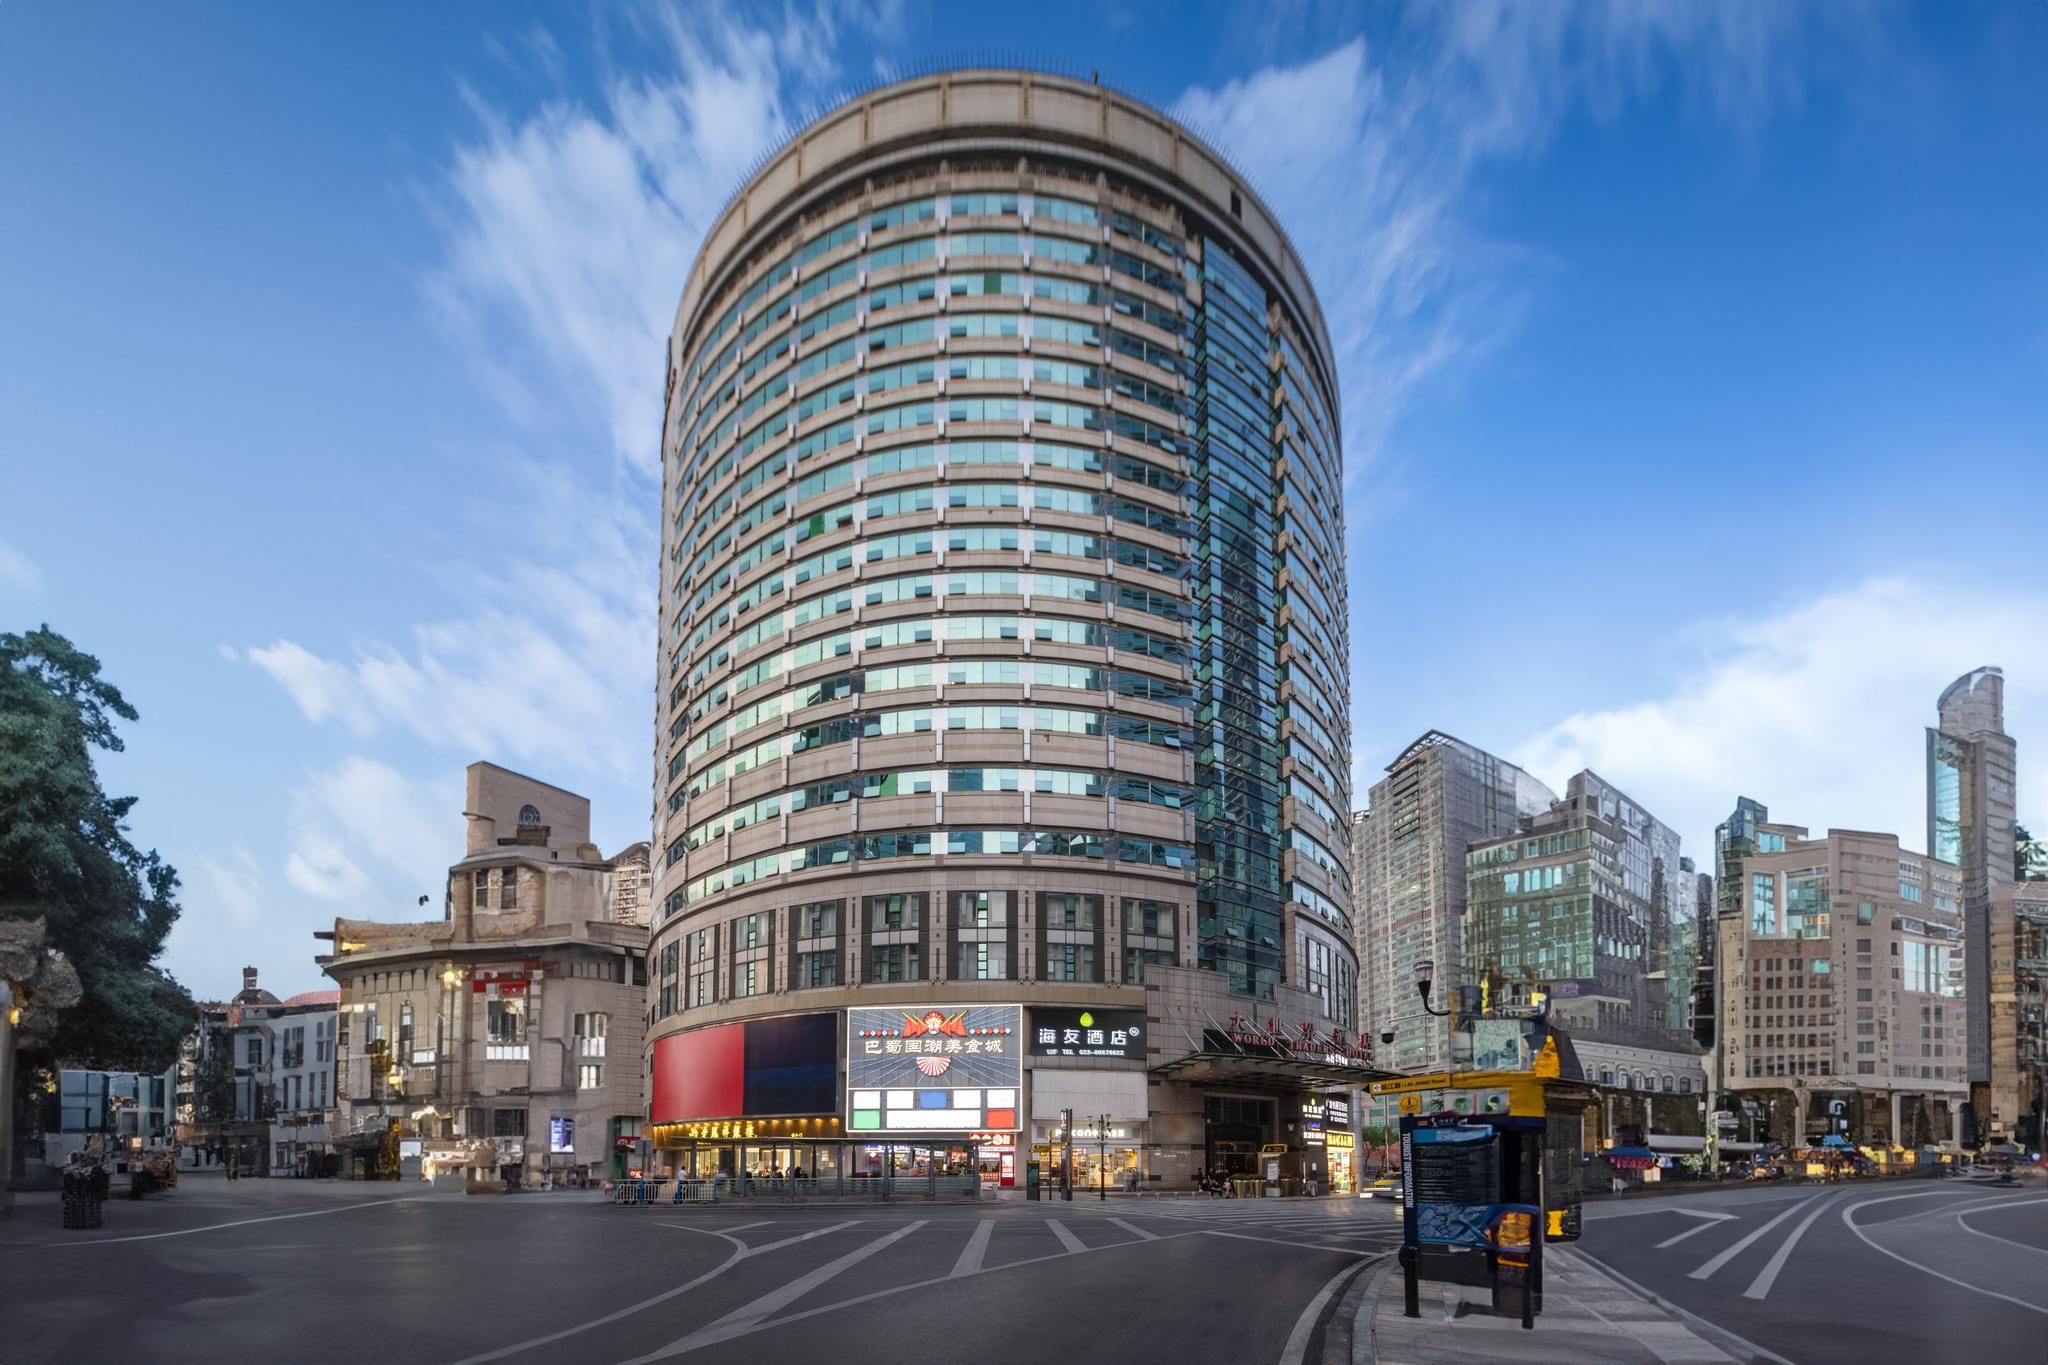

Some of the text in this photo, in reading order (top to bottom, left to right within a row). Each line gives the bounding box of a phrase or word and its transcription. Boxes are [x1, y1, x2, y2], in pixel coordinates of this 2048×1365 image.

[1039, 1028, 1127, 1045] 海友酒店
[865, 1039, 1004, 1054] 巴蜀国潮美食城
[1402, 1132, 1414, 1208] TOURIST INFORMATION
